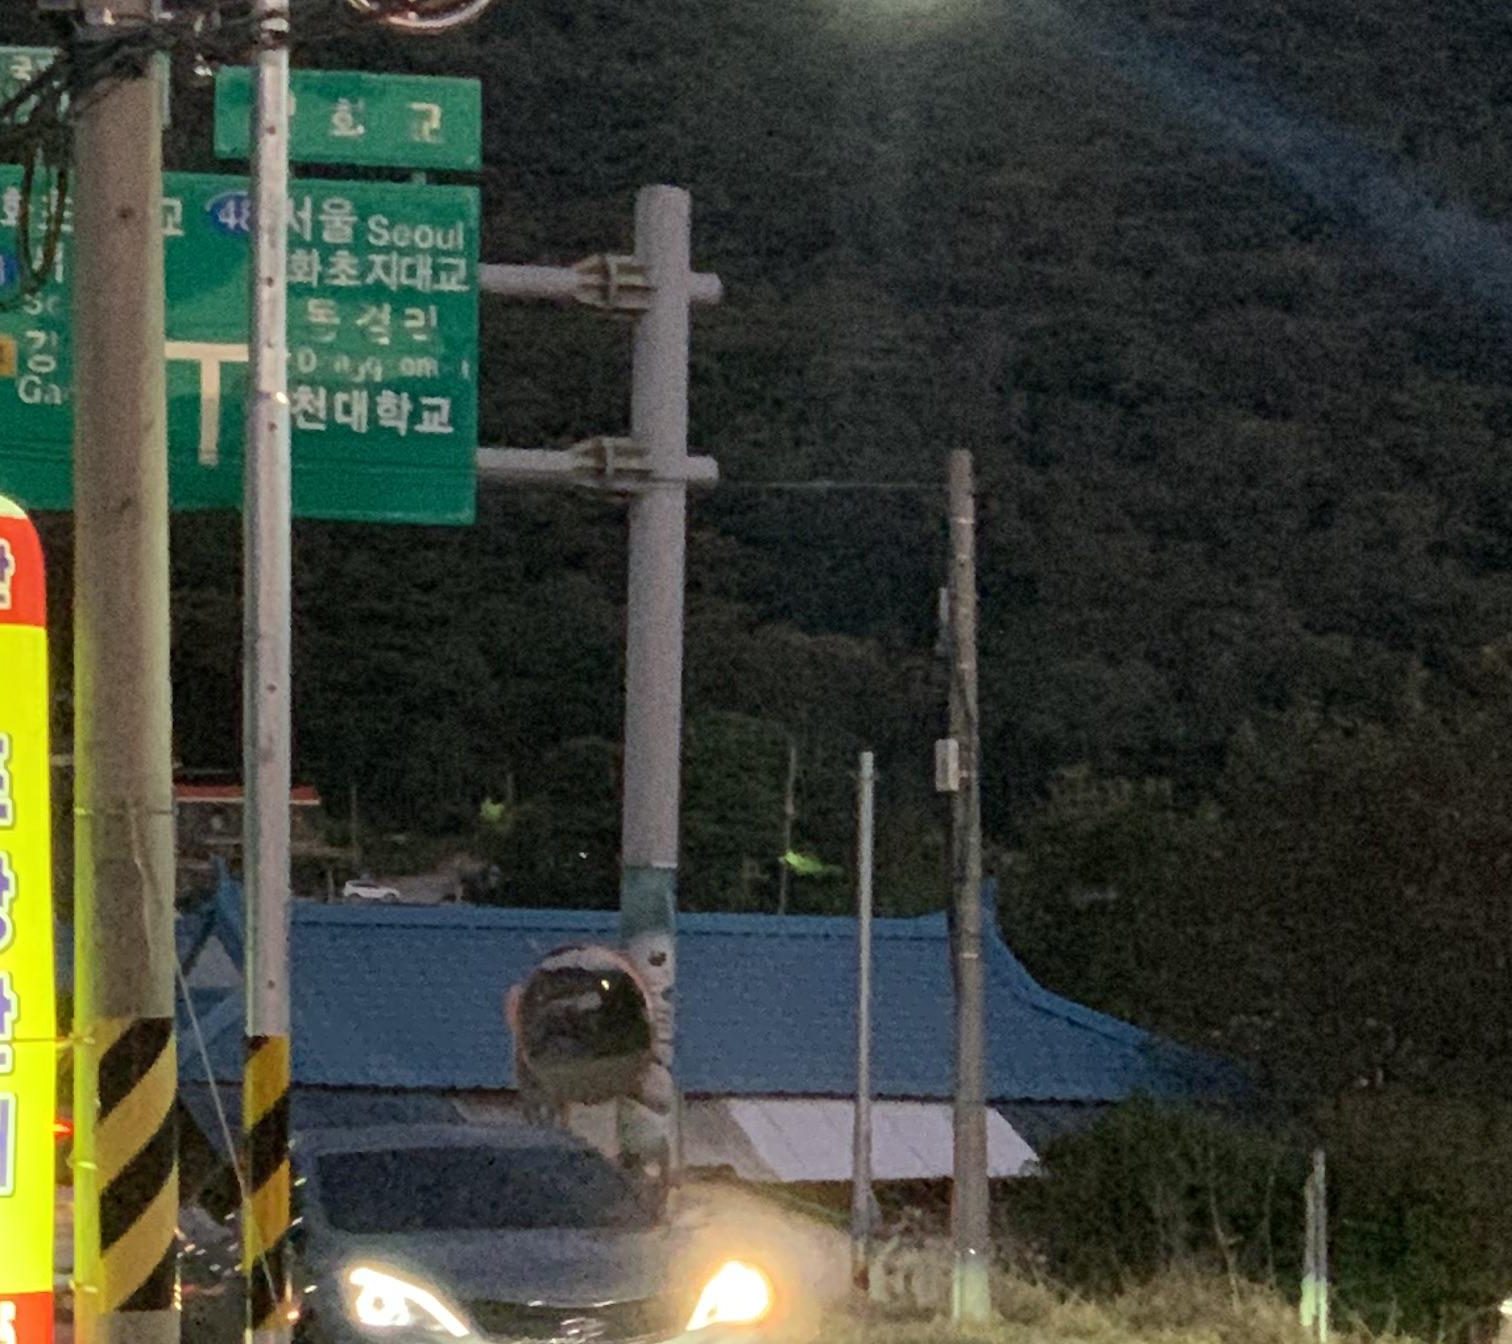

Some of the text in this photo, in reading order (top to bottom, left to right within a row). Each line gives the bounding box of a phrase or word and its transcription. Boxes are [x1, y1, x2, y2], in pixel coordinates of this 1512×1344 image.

[367, 208, 465, 250] Seoul
[287, 252, 469, 294] 화초지대교
[290, 385, 454, 435] 천대학교
